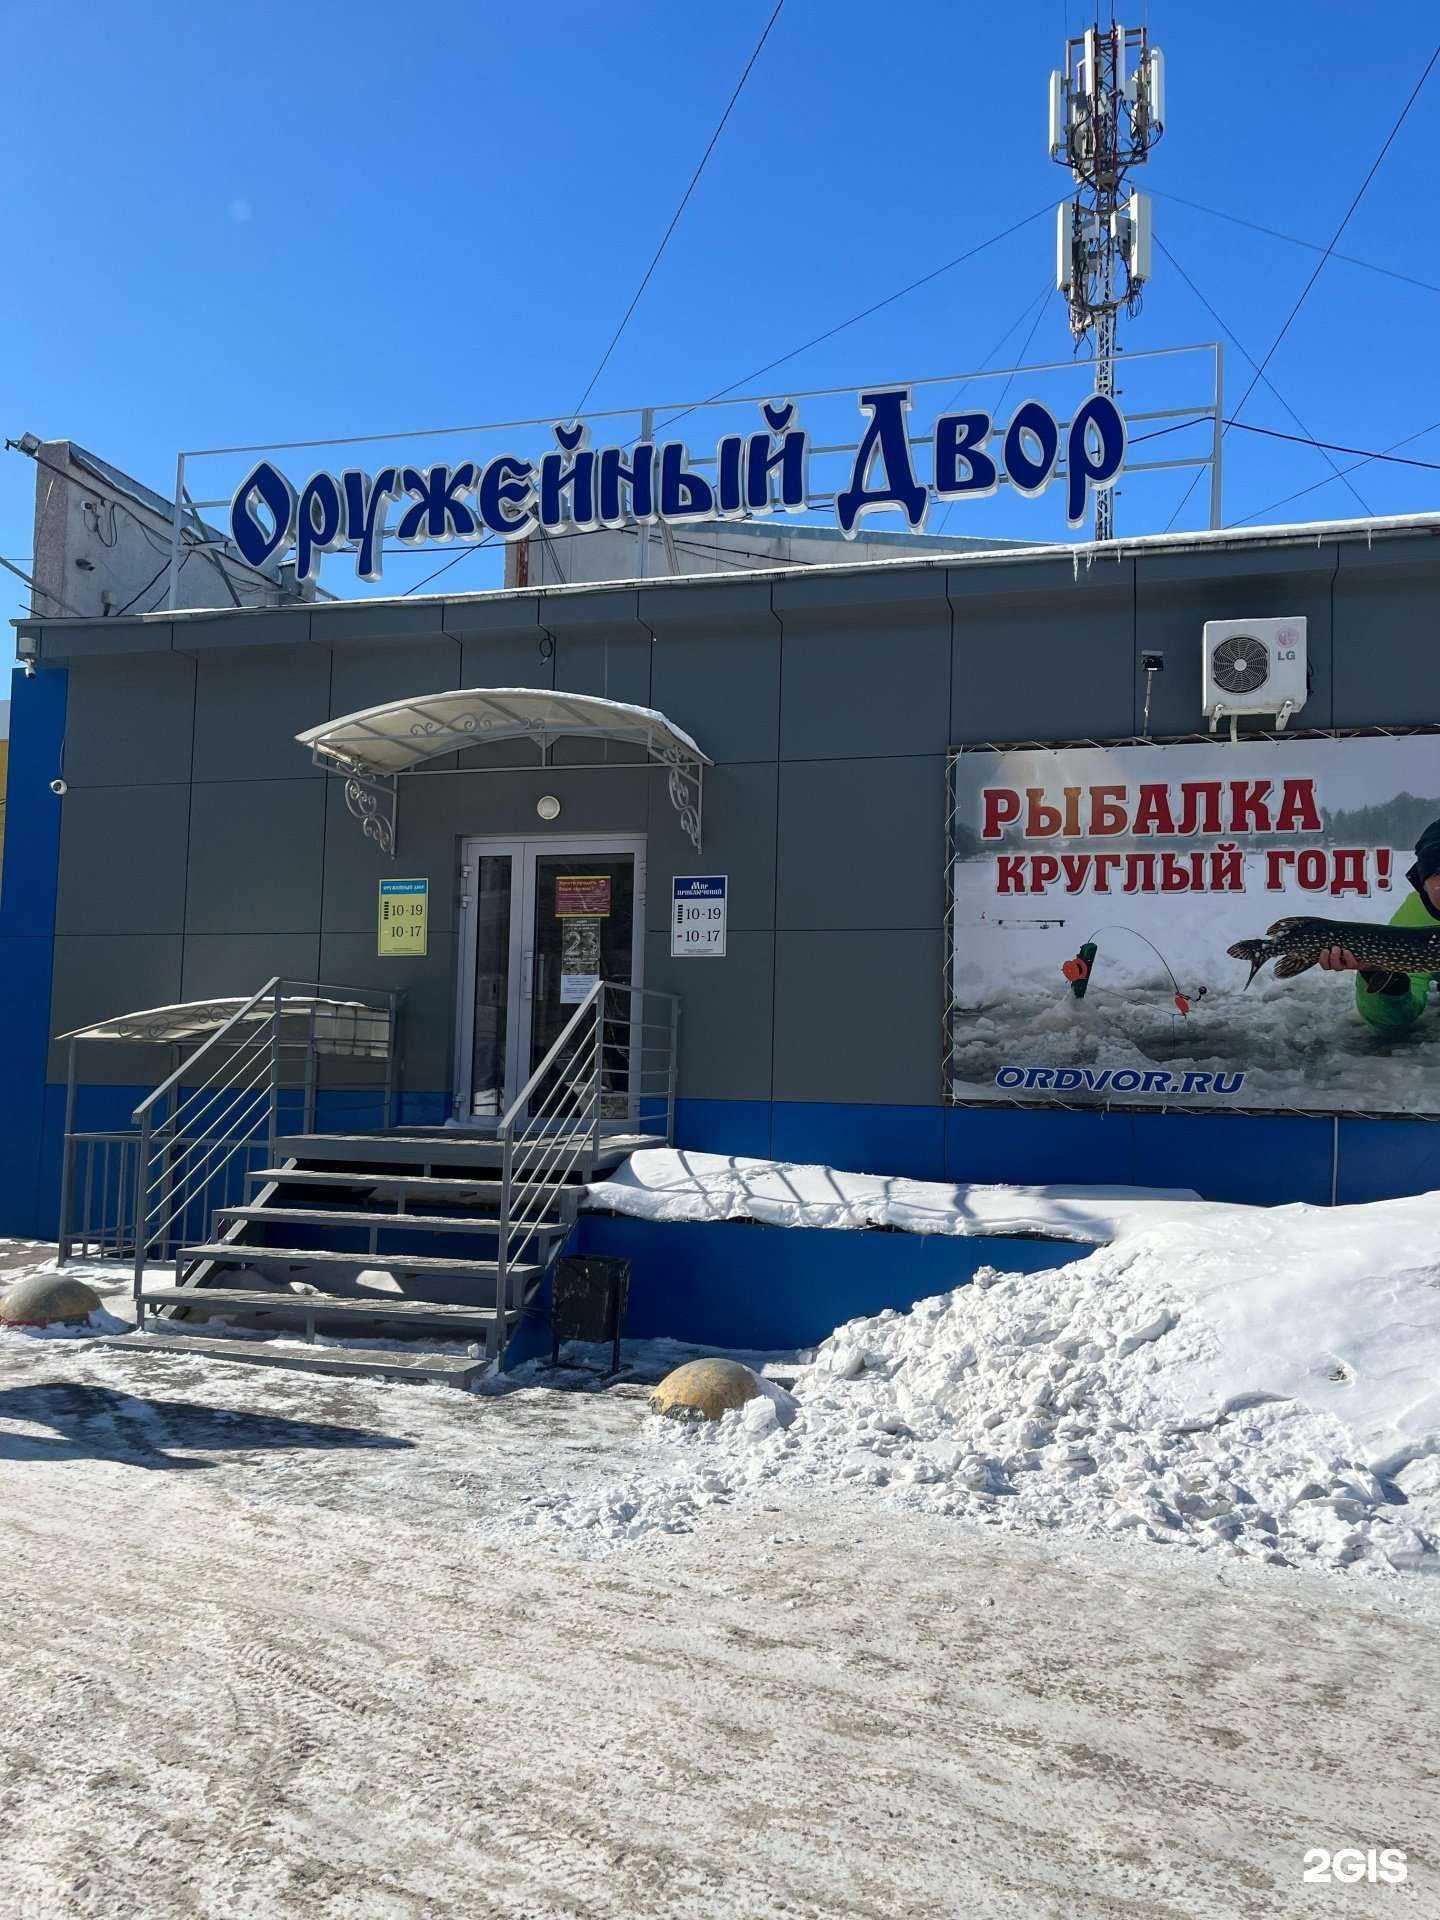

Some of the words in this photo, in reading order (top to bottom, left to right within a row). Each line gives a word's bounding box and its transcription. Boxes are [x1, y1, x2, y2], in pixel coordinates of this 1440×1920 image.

[230, 398, 809, 583] Оружейный
[834, 384, 1129, 541] Двор
[1277, 650, 1296, 661] LG
[981, 778, 1324, 840] РЫБАЛКА
[995, 843, 1247, 895] КРУГЛЫЙ
[1264, 847, 1394, 898] ГОД!
[994, 1065, 1249, 1096] ORDVOR.RU
